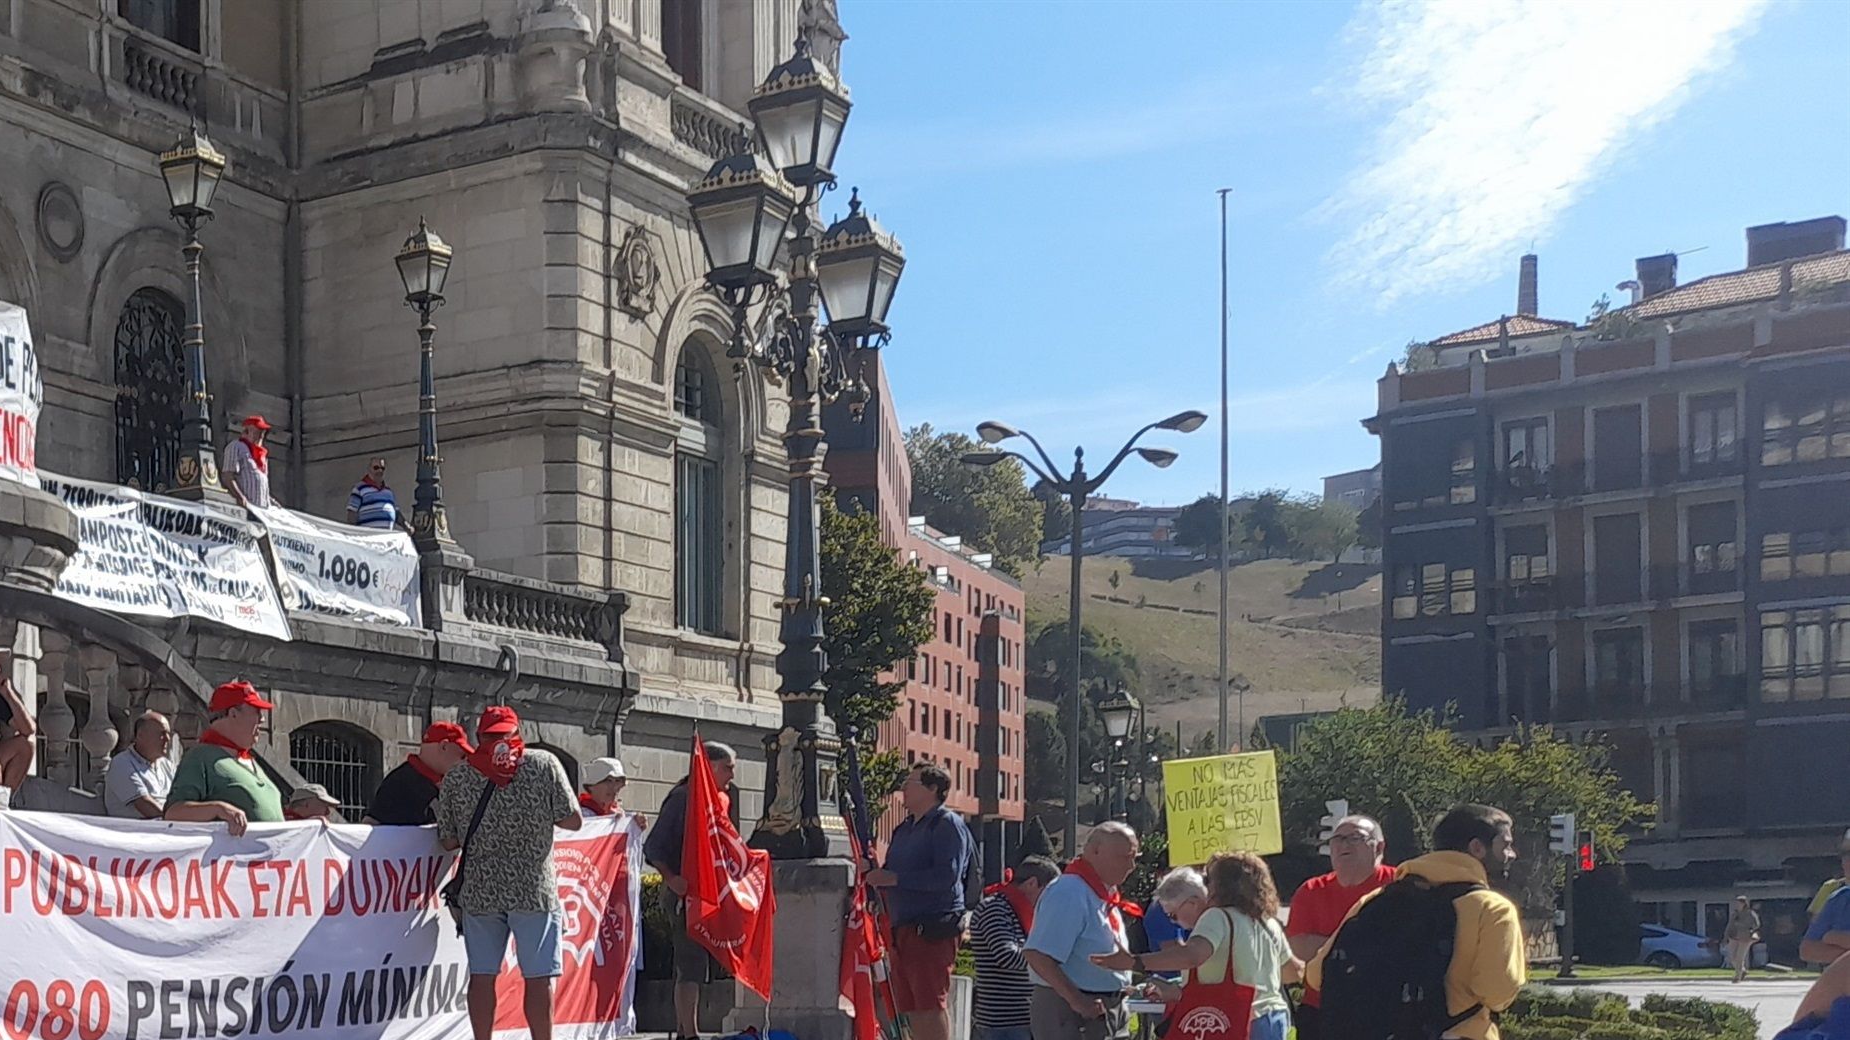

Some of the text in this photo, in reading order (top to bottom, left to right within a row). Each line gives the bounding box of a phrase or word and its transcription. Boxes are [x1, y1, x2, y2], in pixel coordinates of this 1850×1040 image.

[1193, 763, 1214, 784] NO
[1201, 814, 1225, 835] LAS
[1234, 807, 1264, 830] EPSV
[4, 848, 241, 921] PUBLIKOAK
[247, 858, 314, 919] ETA
[324, 855, 445, 917] DUINAK
